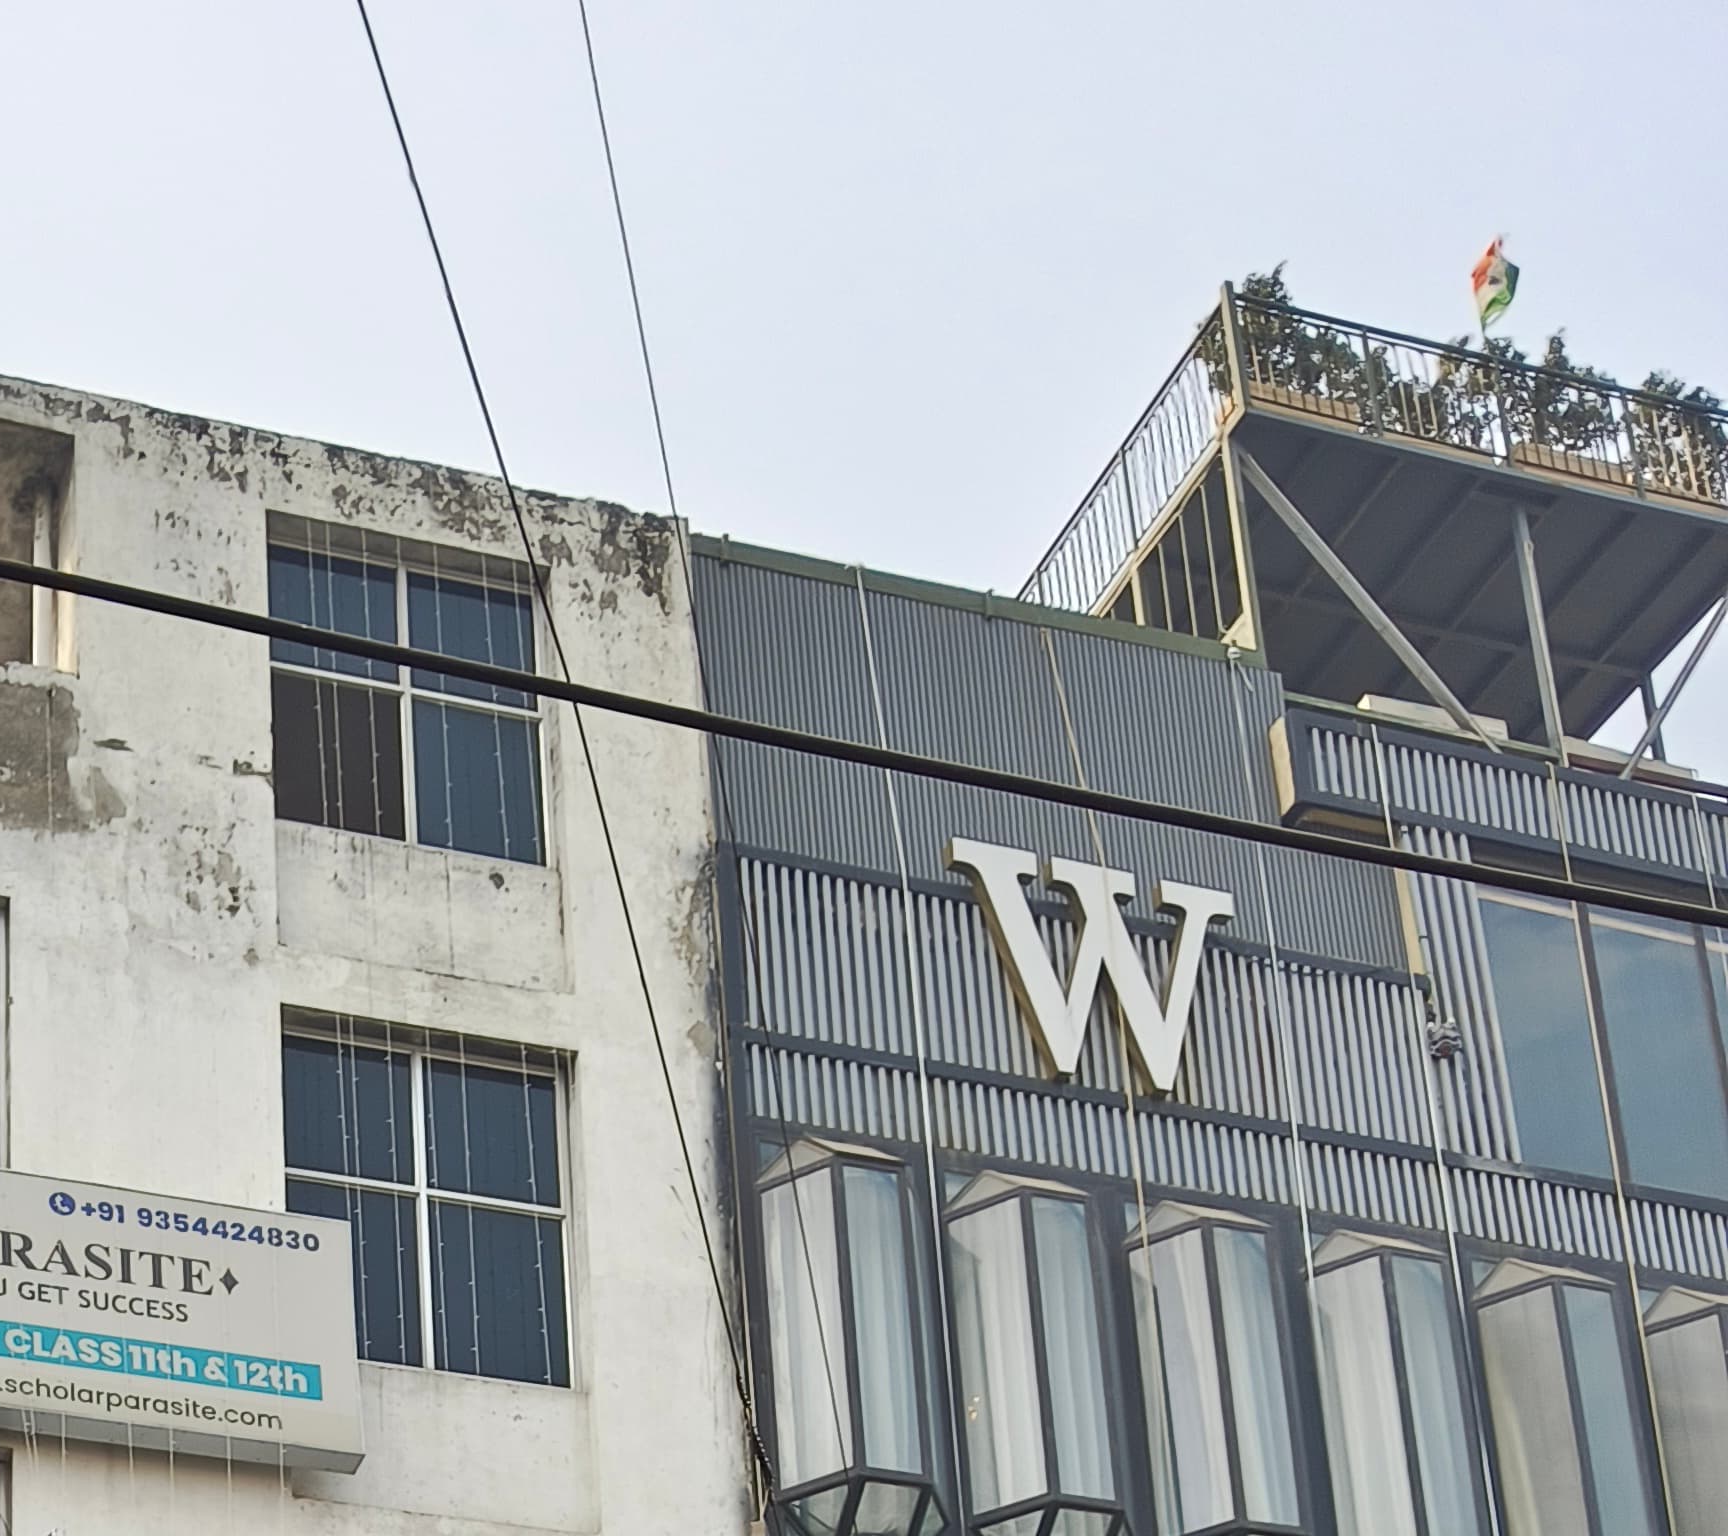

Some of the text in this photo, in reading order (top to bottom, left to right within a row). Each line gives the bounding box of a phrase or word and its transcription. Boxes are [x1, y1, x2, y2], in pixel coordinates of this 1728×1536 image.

[945, 836, 1235, 1094] W
[80, 1201, 321, 1253] +91 9354424830
[17, 1280, 69, 1306] GET
[78, 1289, 189, 1323] SUCCESS
[4, 1328, 309, 1395] CLASS 11th & 12th
